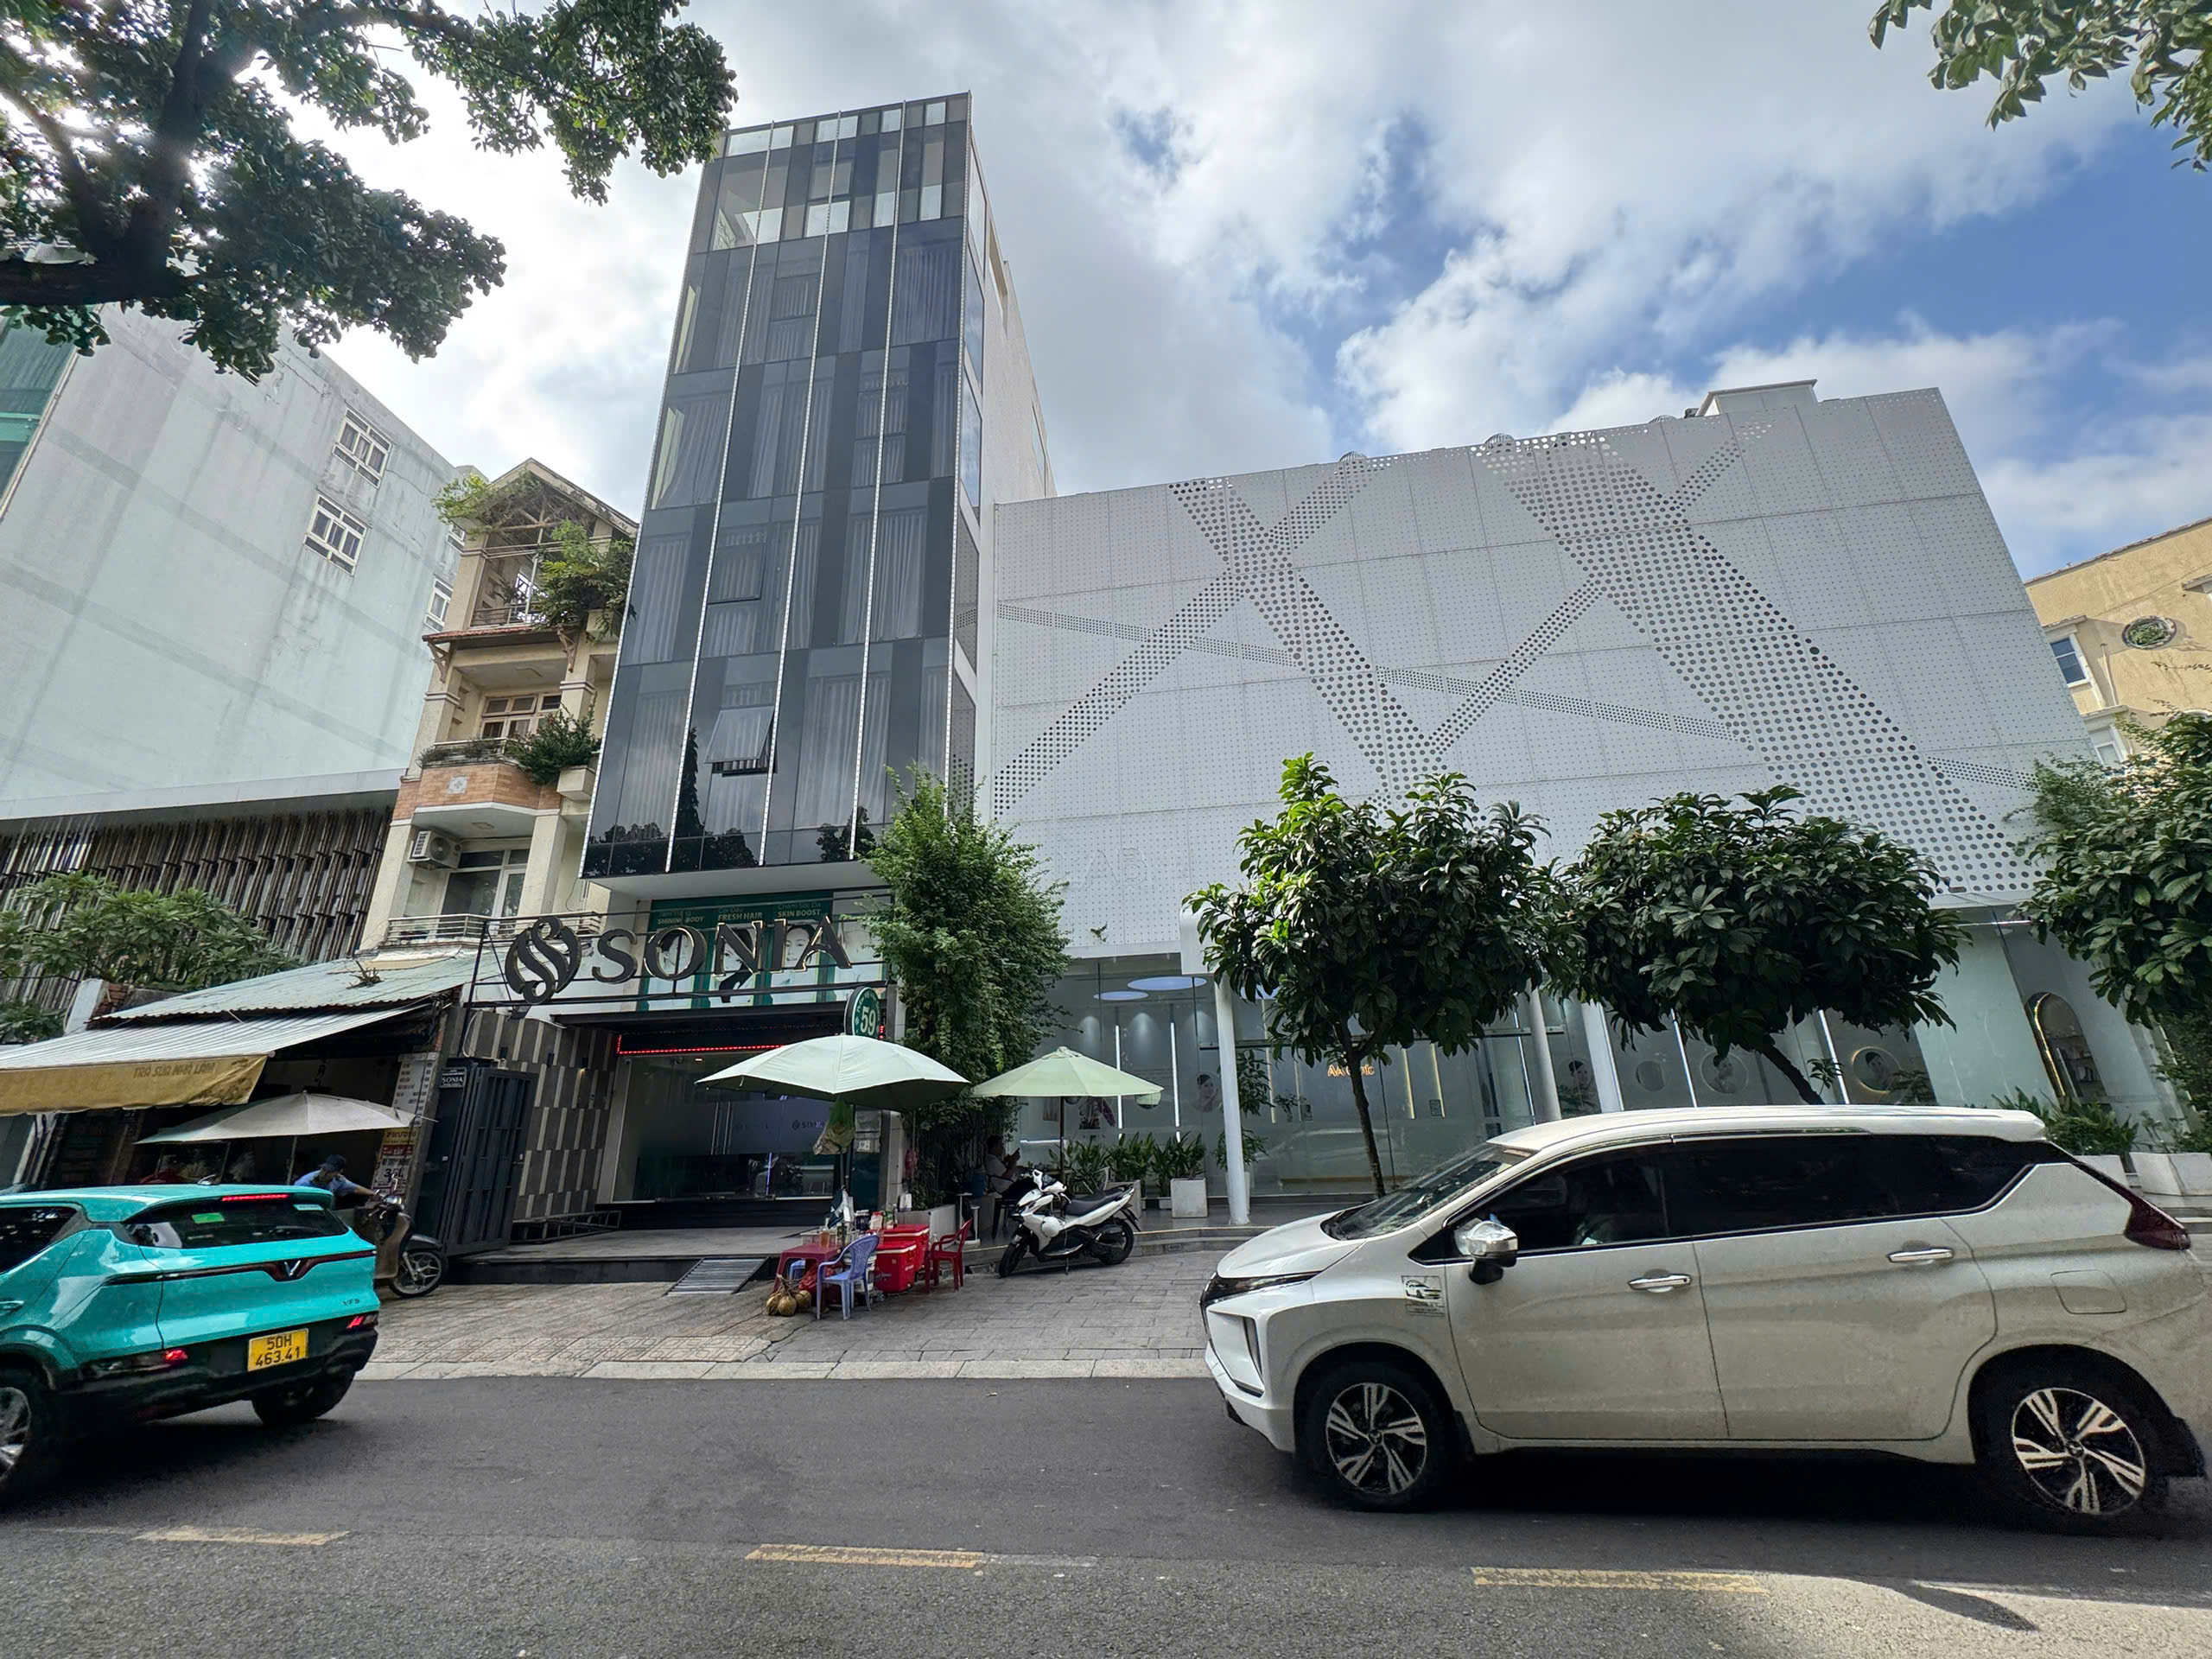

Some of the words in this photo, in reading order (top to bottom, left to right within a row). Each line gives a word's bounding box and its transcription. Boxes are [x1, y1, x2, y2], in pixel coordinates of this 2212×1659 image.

[718, 912, 743, 921] FRESH
[796, 908, 822, 917] BOOST
[591, 914, 853, 984] SONIA
[861, 1005, 876, 1036] 59
[266, 1334, 292, 1351] 50H
[255, 1346, 301, 1367] 463.41
